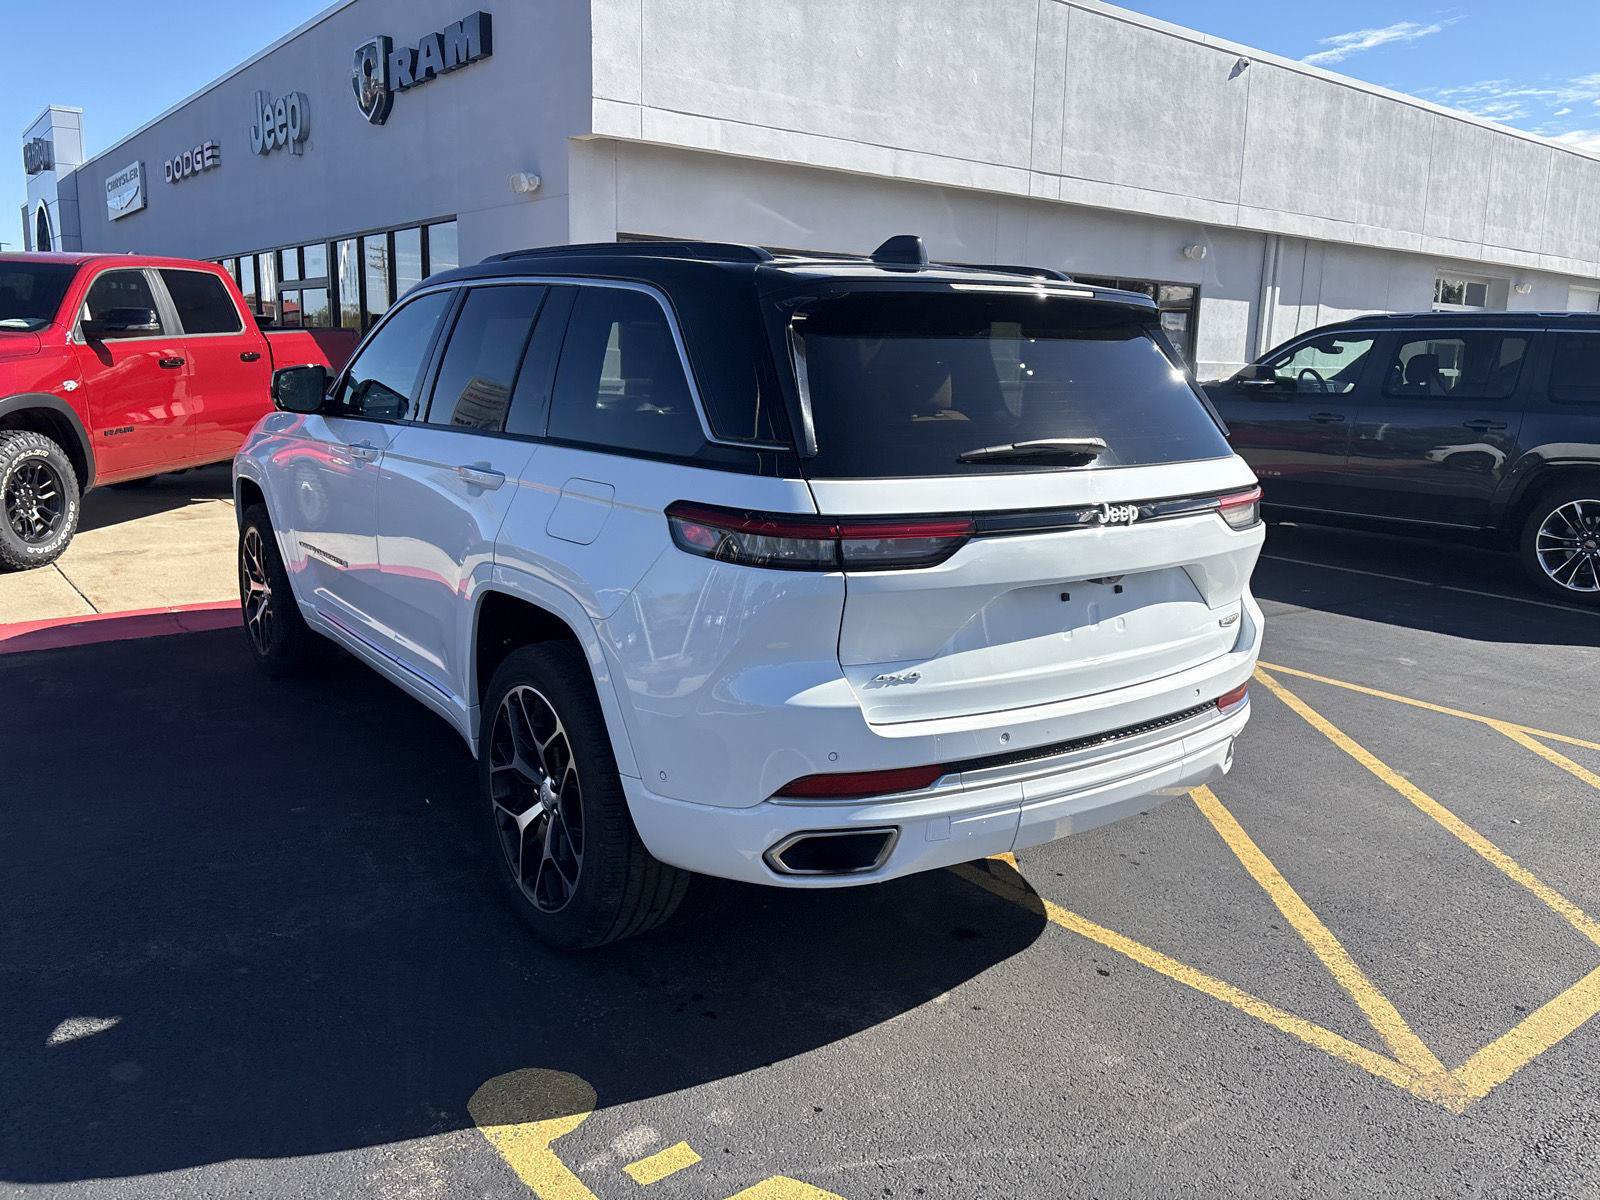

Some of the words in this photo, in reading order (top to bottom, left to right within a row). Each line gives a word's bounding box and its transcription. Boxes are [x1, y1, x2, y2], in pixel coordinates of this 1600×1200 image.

[388, 10, 491, 92] RAM
[251, 90, 308, 155] Jeep
[107, 167, 139, 193] CHRYSLER
[164, 140, 219, 183] DODGE
[1098, 503, 1139, 525] Jeep
